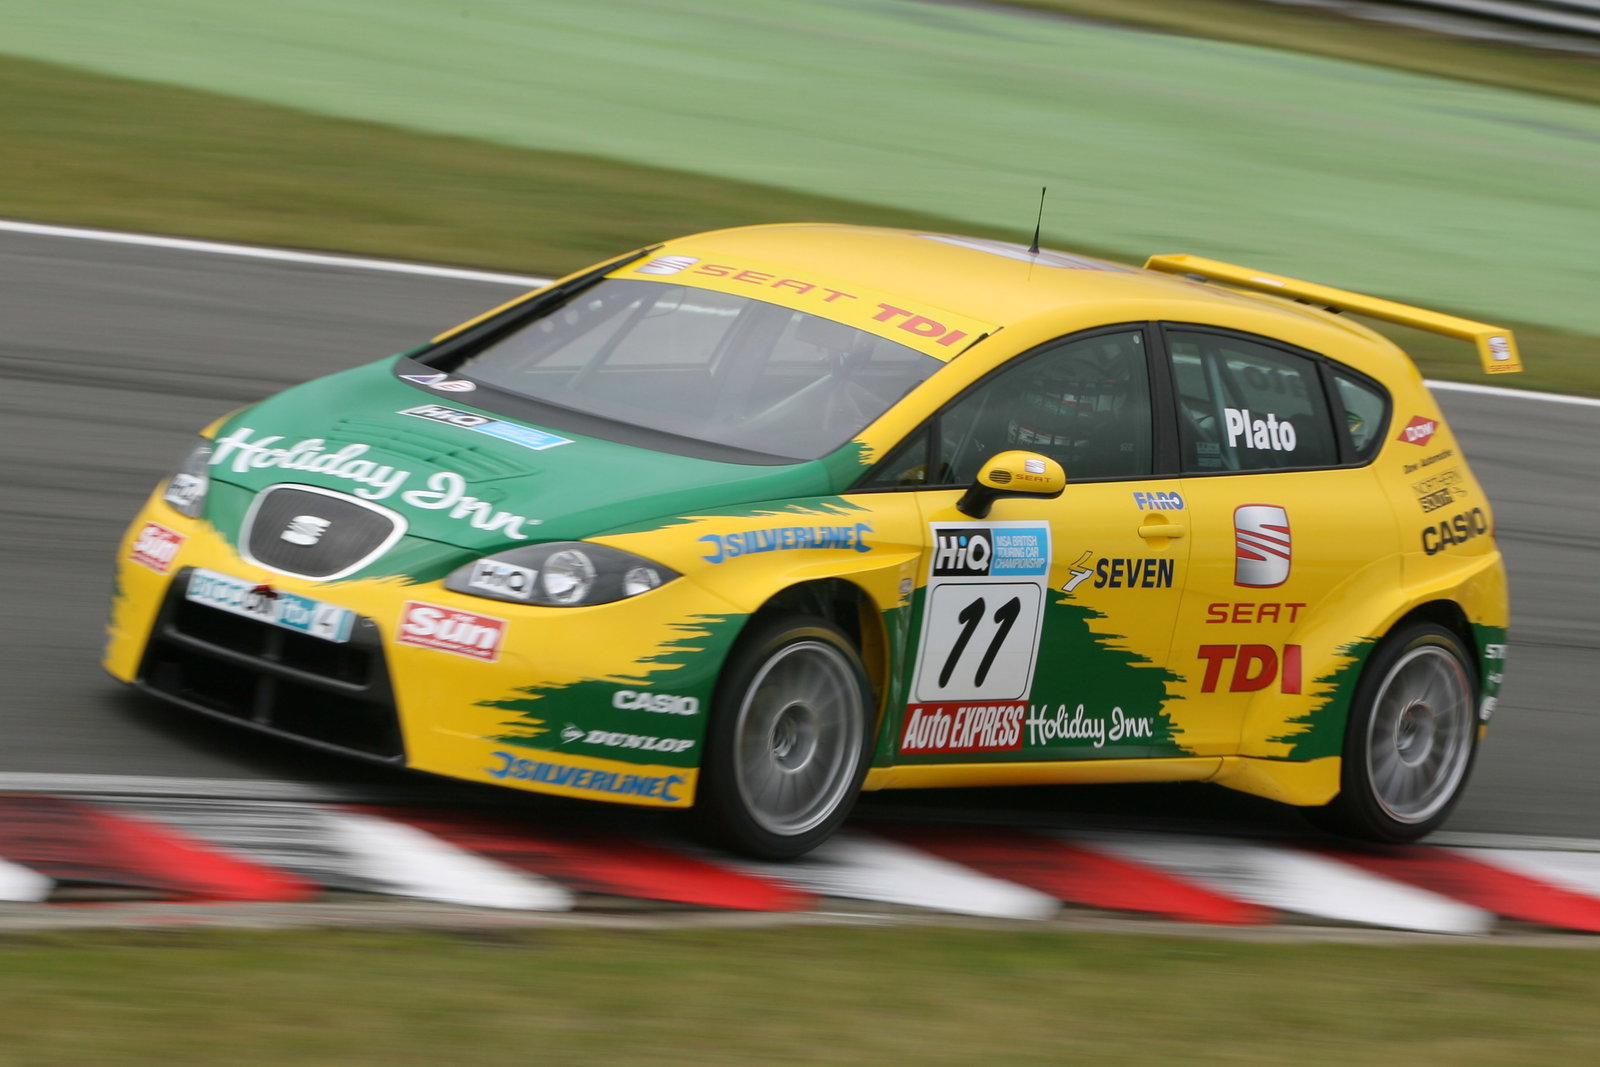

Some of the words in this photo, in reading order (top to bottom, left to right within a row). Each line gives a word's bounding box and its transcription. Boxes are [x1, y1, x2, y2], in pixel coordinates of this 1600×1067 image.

[693, 263, 857, 303] SEAT
[873, 303, 967, 347] TDI
[1223, 408, 1297, 452] Plato
[208, 427, 411, 500] Holiday
[401, 472, 528, 540] Inn
[1015, 473, 1052, 483] SEAT
[1133, 491, 1184, 510] FARO
[1422, 507, 1488, 555] CASIO
[936, 535, 991, 571] HiQ
[994, 558, 1046, 569] CHAMPIONSHIP
[401, 607, 500, 650] Sun
[1205, 602, 1307, 623] SEAT
[938, 596, 1021, 689] 11
[1197, 644, 1302, 695] TDI
[612, 690, 699, 716] CASIO
[582, 730, 696, 752] DUNLOP
[902, 708, 951, 750] Auto
[949, 705, 1024, 749] EXPRESS
[1026, 704, 1105, 748] Holiday
[1109, 707, 1153, 741] Inn
